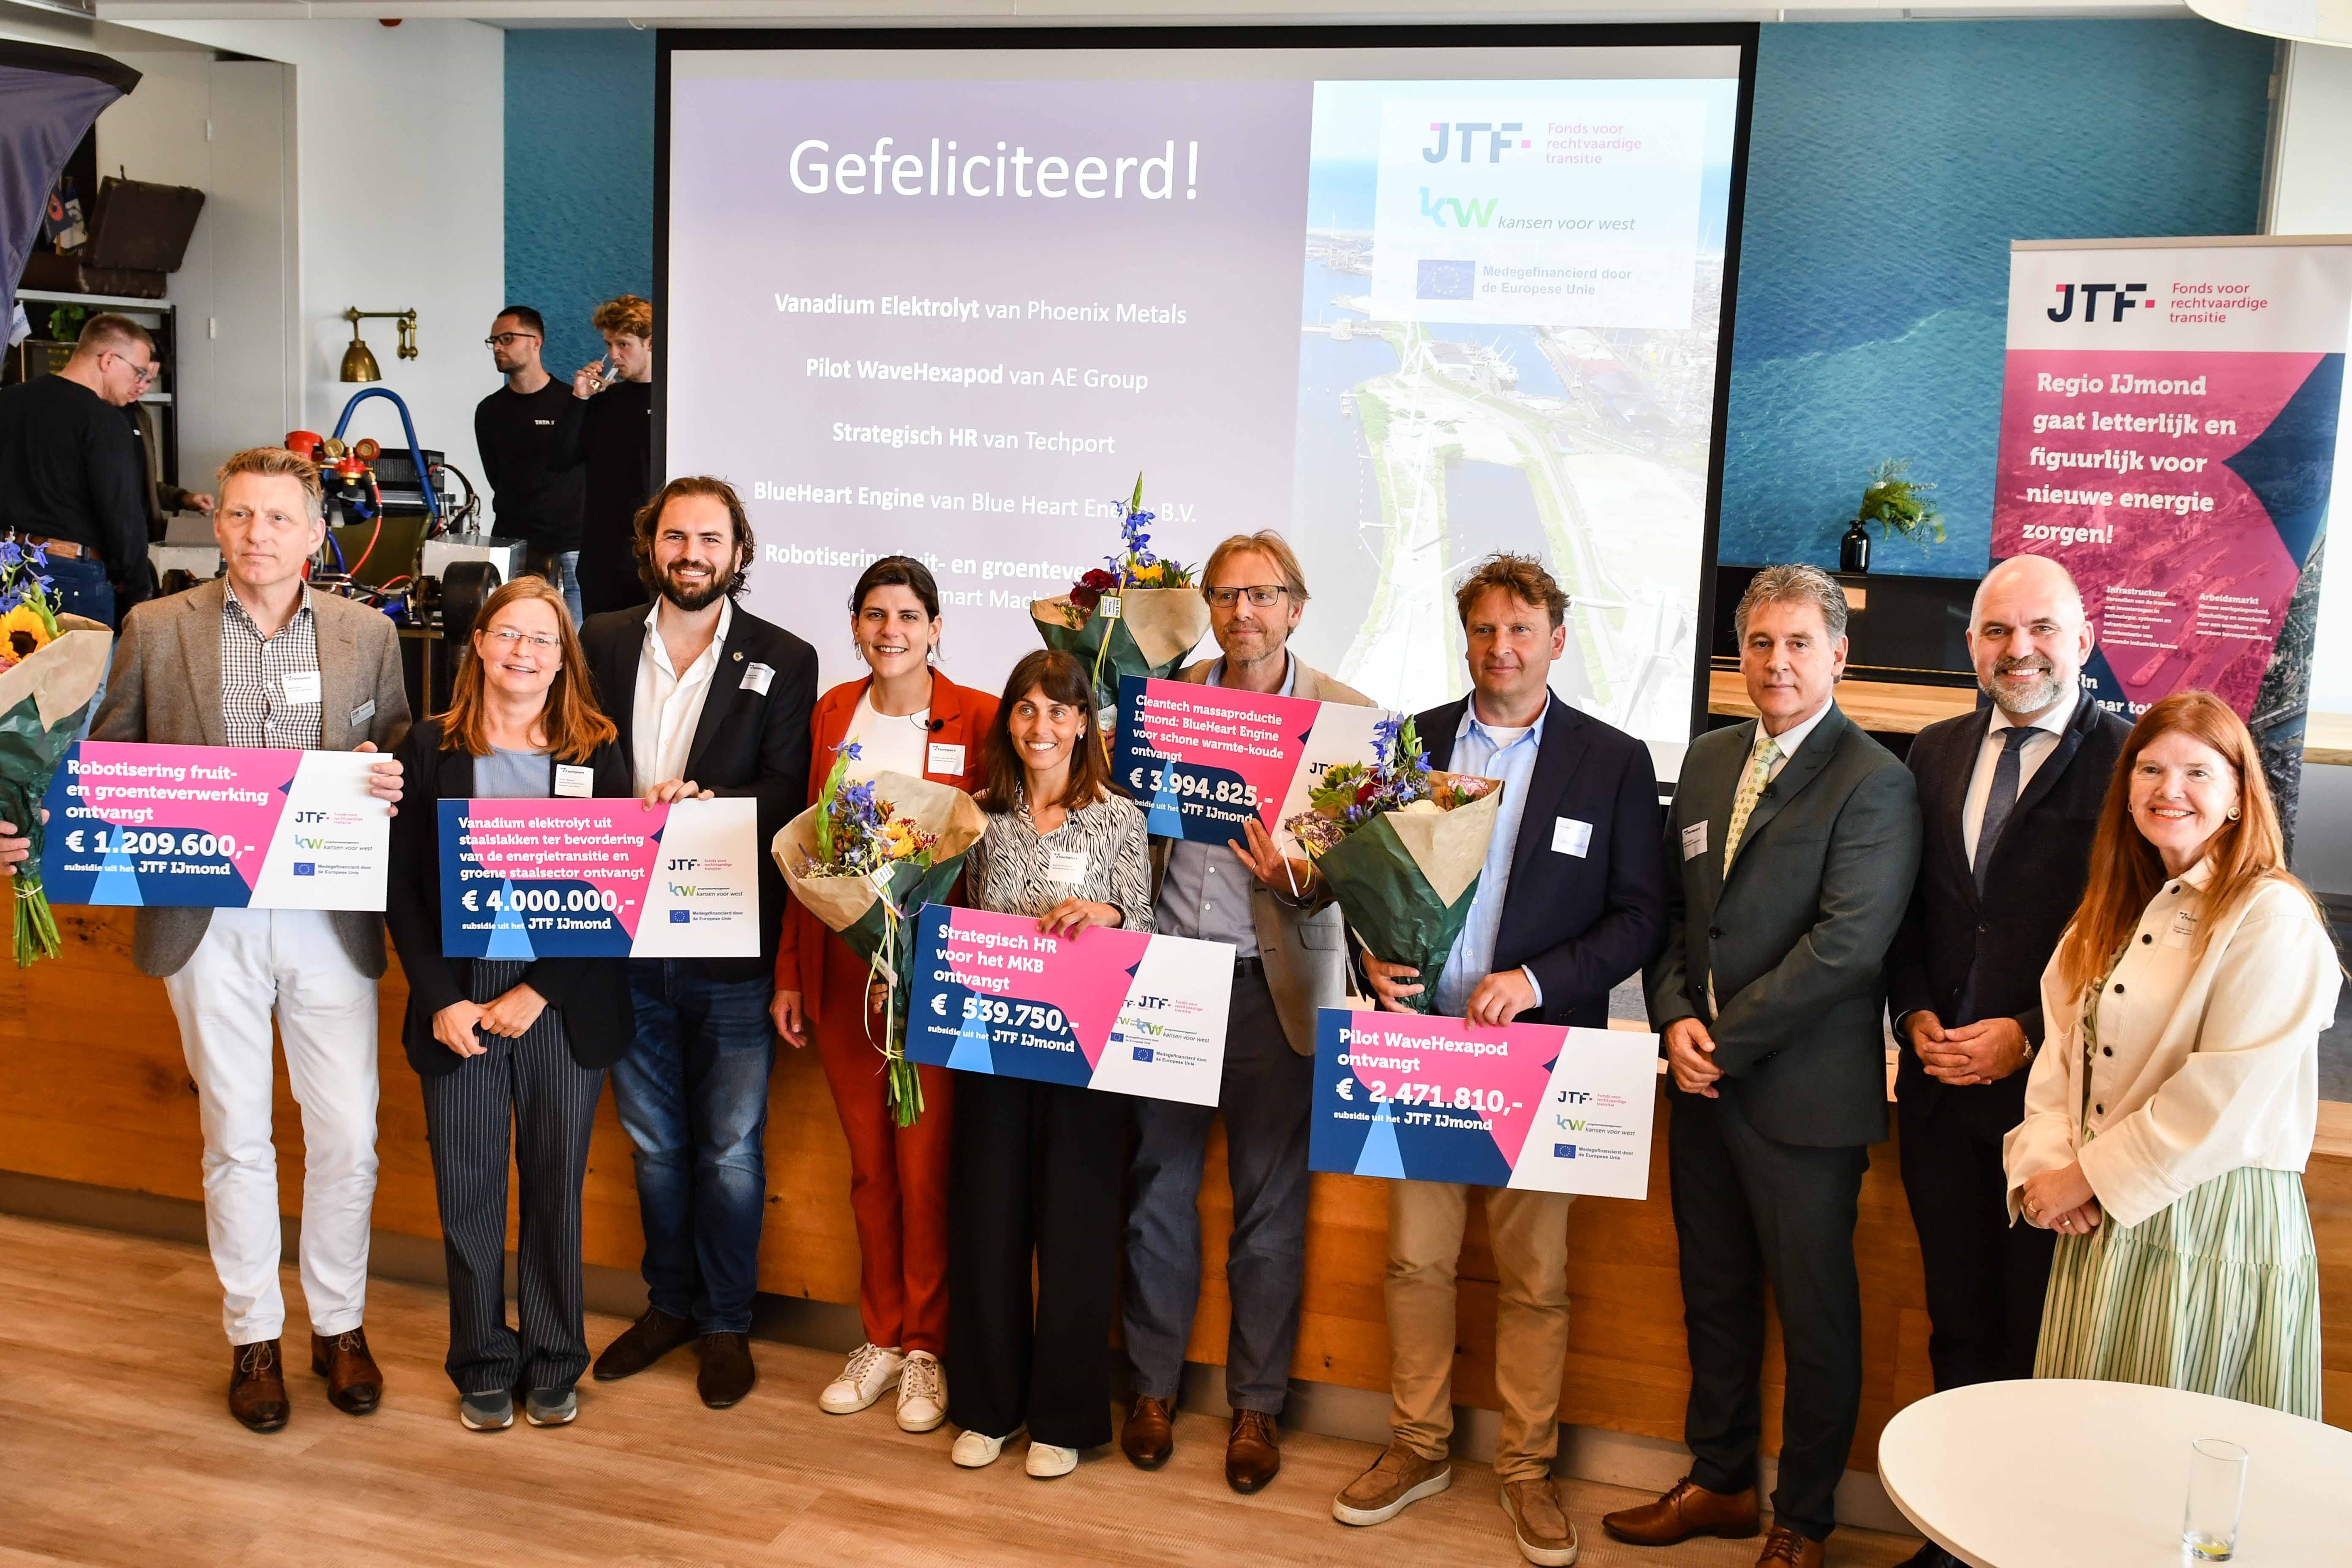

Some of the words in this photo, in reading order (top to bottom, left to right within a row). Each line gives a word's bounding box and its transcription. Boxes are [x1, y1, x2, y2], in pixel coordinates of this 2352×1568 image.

[1548, 122, 1588, 134] Fonds
[1592, 124, 1623, 134] voor
[1423, 123, 1522, 163] JTF
[1547, 138, 1642, 150] rechtvaardige
[790, 137, 1198, 199] Gefeliciteerd!
[1546, 153, 1601, 164] transitie
[1419, 187, 1499, 228] kw
[1498, 216, 1552, 229] kansen
[1558, 218, 1592, 230] voor
[1599, 218, 1636, 230] west
[1483, 266, 1597, 279] Medegefinancierd
[1602, 269, 1632, 279] door
[1482, 283, 1497, 292] de
[1501, 283, 1562, 296] Europese
[1566, 284, 1595, 295] Unie
[2172, 283, 2213, 293] Fonds
[2218, 284, 2249, 294] voor
[775, 294, 874, 314] Vanadium
[882, 296, 979, 322] Elektrolyt
[985, 305, 1020, 318] van
[1028, 300, 1109, 321] Phoenix
[1117, 304, 1186, 324] Metals
[2047, 283, 2147, 322] JTF
[2171, 297, 2268, 310] rechtvaardige
[2170, 312, 2226, 323] transitie
[807, 358, 851, 378] Pilot
[857, 360, 1003, 387] WaveHexapod
[1010, 371, 1044, 385] van
[1051, 368, 1077, 386] AE
[1084, 369, 1148, 393] Group
[2038, 373, 2103, 397] Regio
[2110, 374, 2206, 395] IJmond
[2034, 413, 2085, 433] gaat
[2092, 411, 2198, 438] letterlijk
[2205, 420, 2236, 435] en
[833, 422, 942, 448] Strategisch
[950, 428, 977, 446] HR
[983, 434, 1018, 449] van
[1025, 431, 1115, 455] Techport
[2030, 446, 2144, 474] figuurlijk
[2150, 456, 2208, 472] voor
[755, 481, 852, 504] BlueHeart
[859, 487, 924, 510] Engine
[930, 495, 964, 510] van
[973, 492, 1014, 512] Blue
[1022, 495, 1078, 516] Heart
[1085, 498, 1155, 519] Ene
[1162, 503, 1195, 523] B.V.
[2027, 484, 2113, 506] nieuwe
[2120, 492, 2213, 515] energie
[2023, 525, 2113, 546] zorgen!
[765, 544, 890, 568] Robotiserin
[896, 549, 946, 572] it-
[952, 558, 976, 574] en
[982, 560, 1110, 580] groenteve
[937, 590, 983, 606] mart
[2107, 585, 2167, 597] Infrastructuur
[2199, 593, 2259, 604] Arbeidsmarkt
[1136, 695, 1190, 712] Cleantech
[1193, 705, 1282, 725] massaproductie
[2096, 700, 2124, 712] aar
[1135, 710, 1179, 727] IJmond:
[1183, 718, 1236, 735] BlueHeart
[1240, 726, 1279, 741] Engine
[1133, 729, 1158, 740] voor
[1160, 732, 1199, 746] schone
[1202, 740, 1283, 759] warmte-koude
[1132, 747, 1182, 763] ontvangt
[68, 760, 186, 781] Robotisering
[191, 765, 237, 779] fruit-
[1309, 762, 1335, 775] JT
[67, 785, 90, 796] en
[95, 786, 269, 806] groenteverwerking
[1130, 768, 1143, 789] €
[1149, 770, 1273, 811] 3.994.825,-
[66, 806, 153, 823] ontvangt
[295, 812, 326, 823] JTF
[458, 817, 525, 828] Vanadium
[528, 817, 590, 830] elektrolyt
[594, 817, 612, 828] uit
[1168, 804, 1179, 812] het
[1182, 803, 1204, 816] JTF
[1206, 806, 1253, 823] IJmond
[66, 830, 85, 852] €
[93, 830, 255, 860] 1.209.600,-
[460, 834, 539, 845] staalslakken
[542, 835, 561, 844] ter
[564, 834, 644, 847] bevordering
[64, 863, 103, 872] subsidie
[118, 864, 134, 872] het
[139, 860, 167, 873] JTF
[170, 862, 230, 875] IJmond
[460, 853, 484, 861] van
[487, 851, 502, 861] de
[506, 850, 609, 864] energietransitie
[613, 853, 629, 861] en
[668, 859, 697, 870] JTF
[460, 869, 506, 881] groene
[510, 867, 580, 878] staalsector
[583, 868, 645, 880] ontvangt
[462, 890, 479, 911] €
[485, 890, 635, 915] 4.000.000,-
[462, 922, 496, 930] subsidie
[511, 922, 525, 930] het
[528, 918, 554, 930] JTF
[557, 918, 612, 930] IJmond
[939, 925, 1028, 950] Strategisch
[1034, 937, 1056, 953] HR
[936, 949, 973, 963] voor
[978, 951, 1003, 968] het
[1007, 956, 1043, 973] MKB
[934, 970, 1010, 992] ontvangt
[931, 994, 947, 1015] €
[962, 997, 1080, 1036] 539.750,-
[927, 1026, 961, 1037] subsidie
[962, 1030, 975, 1039] uit
[976, 1032, 989, 1040] het
[993, 1029, 1018, 1043] JTF
[1021, 1033, 1075, 1053] IJmond
[1339, 1029, 1379, 1045] Pilot
[1384, 1032, 1508, 1057] WaveHexapod
[1338, 1054, 1420, 1073] ontvangt
[1336, 1078, 1354, 1100] €
[1369, 1081, 1523, 1117] 2.471.810,-
[1558, 1091, 1590, 1104] JTF
[1334, 1111, 1370, 1122] subsidie
[1372, 1113, 1385, 1122] uit
[1386, 1114, 1400, 1123] het
[1404, 1112, 1432, 1126] JTF
[1435, 1115, 1493, 1131] IJmond
